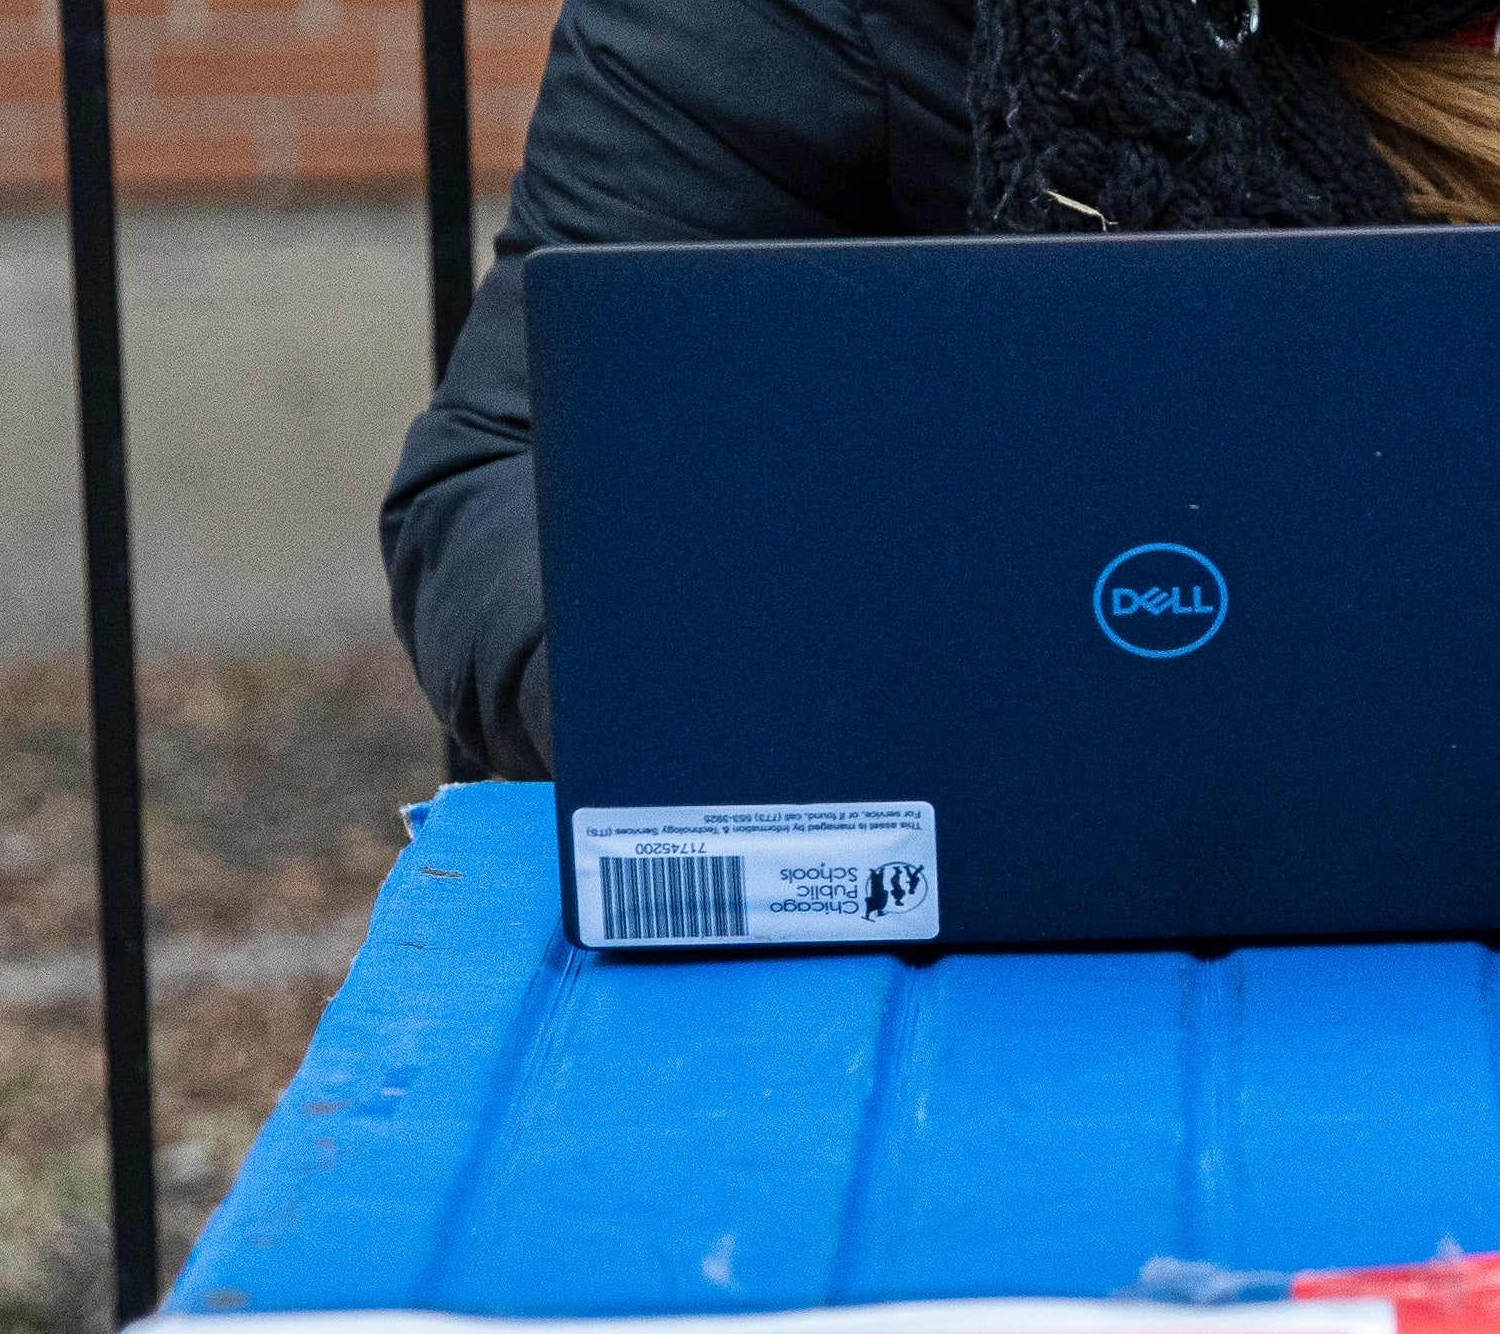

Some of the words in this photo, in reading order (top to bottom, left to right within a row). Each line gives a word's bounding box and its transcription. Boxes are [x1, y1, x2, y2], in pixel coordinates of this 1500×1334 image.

[1111, 585, 1214, 616] DELL
[785, 812, 802, 822] call
[837, 812, 846, 821] if
[904, 810, 921, 819] For
[661, 825, 720, 836] Technology
[722, 825, 730, 835] &
[732, 824, 790, 834] Information
[792, 823, 805, 833] by
[807, 822, 855, 833] managed
[858, 822, 867, 831] is
[870, 821, 897, 831] asset
[900, 821, 923, 831] This
[586, 827, 612, 837] (ITS)
[614, 827, 660, 836] Services
[635, 842, 708, 855] 71745200
[780, 866, 858, 883] Schools
[796, 884, 858, 900] Public
[769, 898, 859, 915] Chicago
